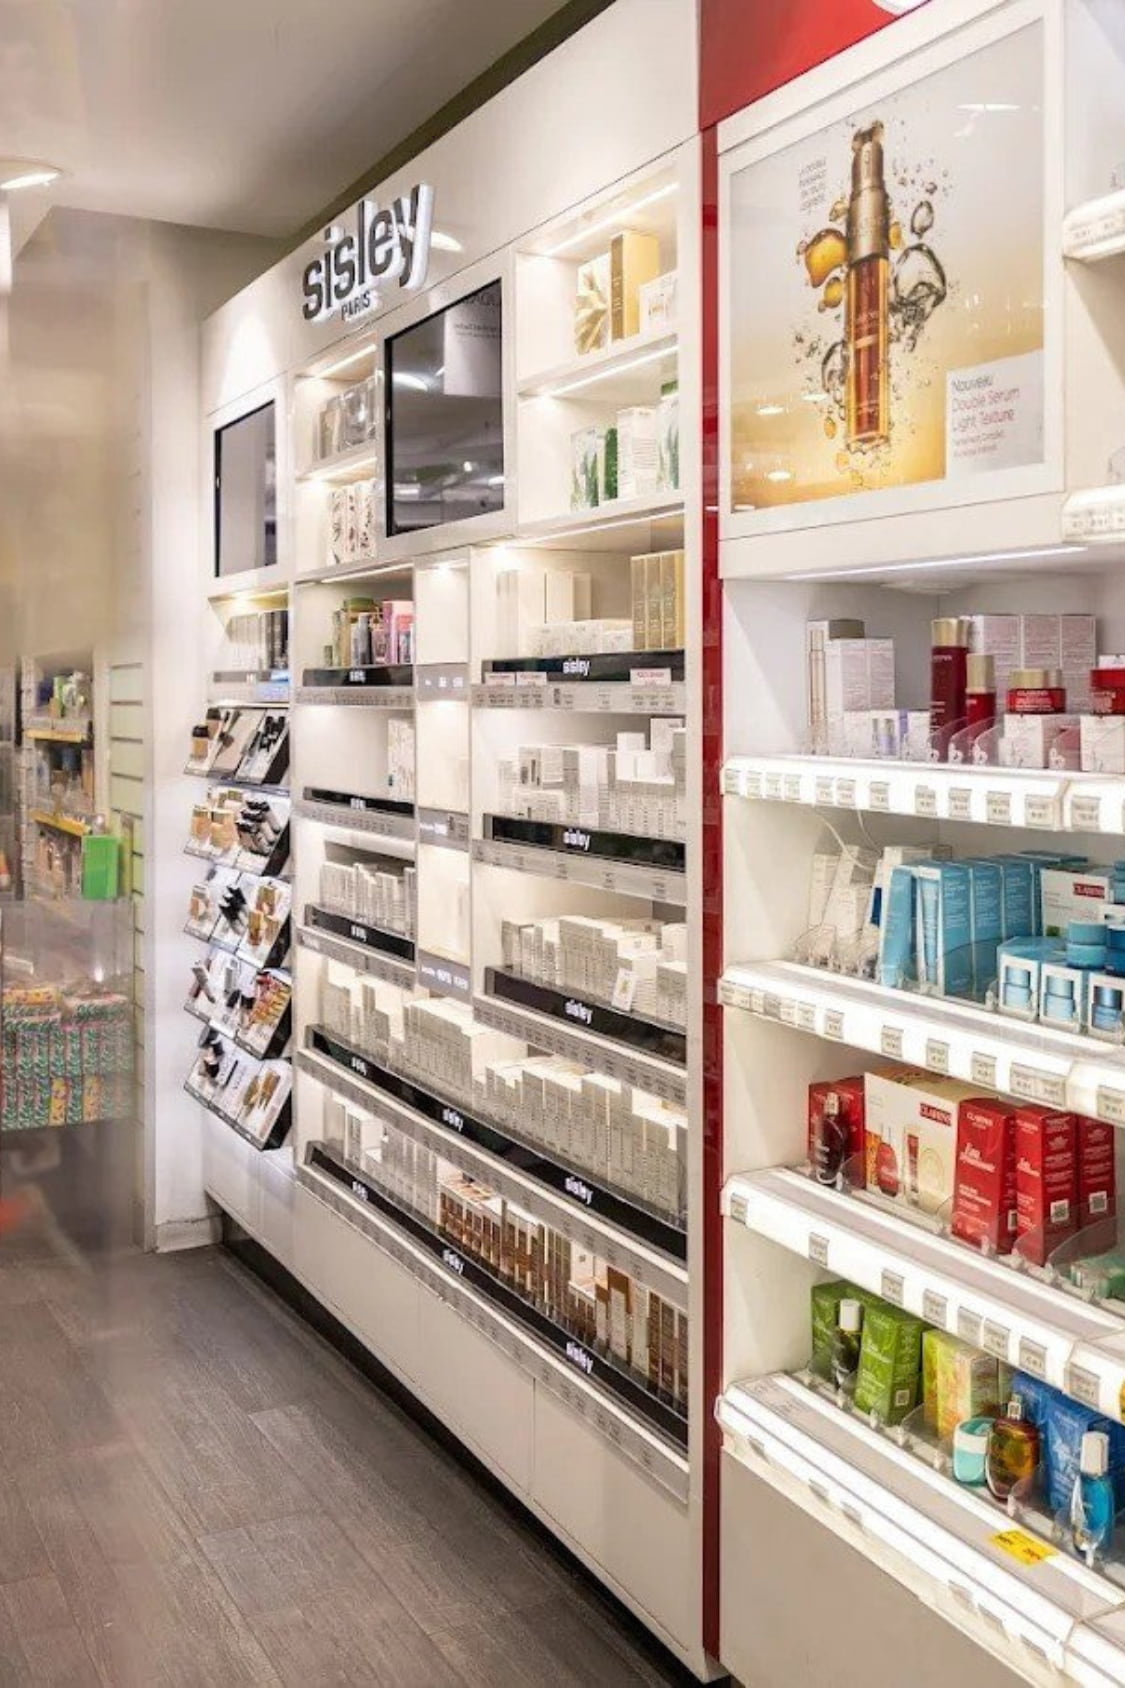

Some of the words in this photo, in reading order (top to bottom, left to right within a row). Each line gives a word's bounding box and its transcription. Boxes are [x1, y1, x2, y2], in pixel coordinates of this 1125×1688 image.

[302, 184, 430, 320] sisley
[341, 289, 371, 319] PARIS
[562, 658, 590, 676] sisley
[563, 828, 590, 851] sisley
[565, 999, 593, 1024] sisley
[565, 1176, 593, 1204] sisley
[566, 1341, 593, 1374] sisley
